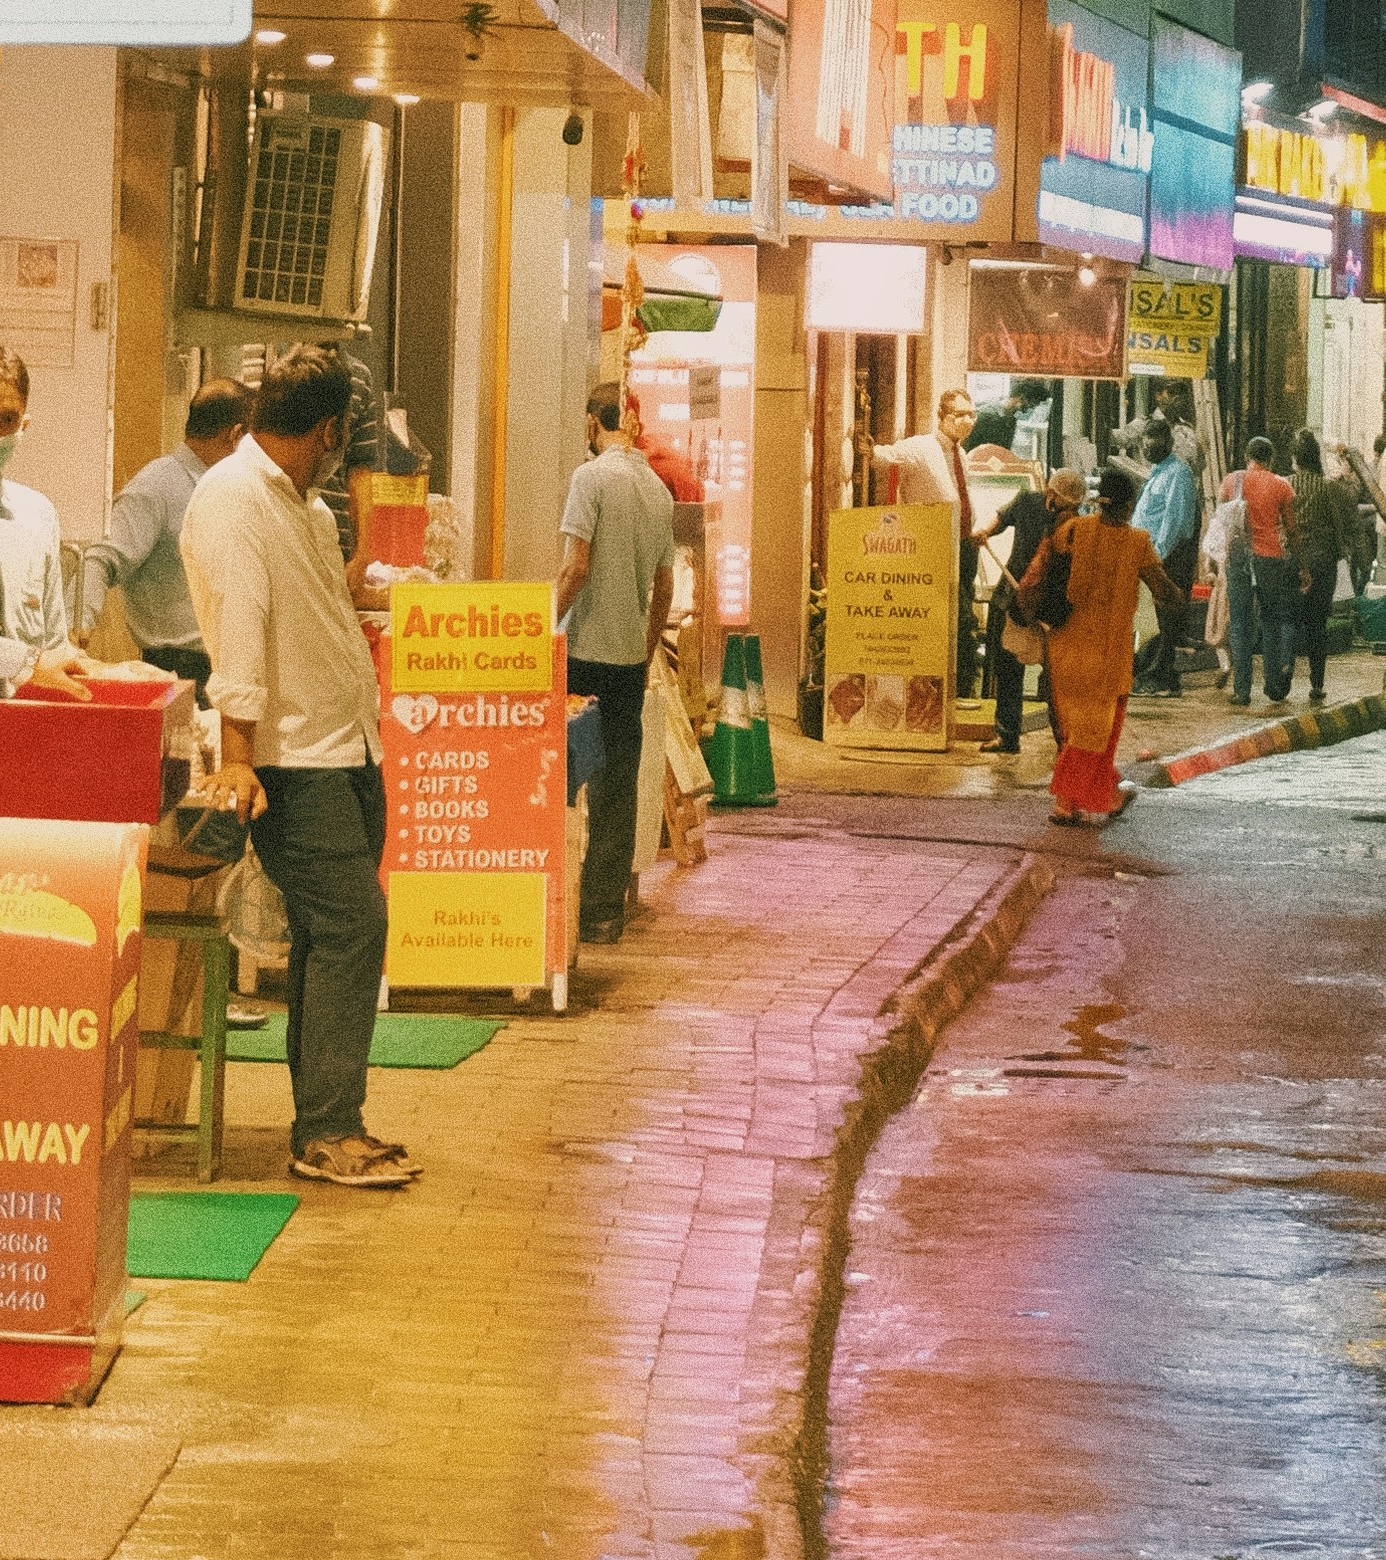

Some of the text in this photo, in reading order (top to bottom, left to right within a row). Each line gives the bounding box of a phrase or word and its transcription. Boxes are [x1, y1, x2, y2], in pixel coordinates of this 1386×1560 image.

[902, 192, 979, 220] FOOD
[844, 570, 933, 586] CAR DINING
[883, 588, 893, 601] &
[402, 605, 544, 638] Archies
[845, 604, 930, 620] TAKE AWAY
[407, 652, 538, 671] Rakhi Cards
[408, 695, 545, 728] archies
[414, 751, 490, 770] CARDS
[415, 775, 478, 794] GIFTS
[415, 800, 489, 819] BOOKS
[415, 824, 471, 843] TOYS
[414, 848, 549, 869] STATIONERY
[433, 910, 502, 926] Rakhi's
[400, 932, 534, 949] Available Here
